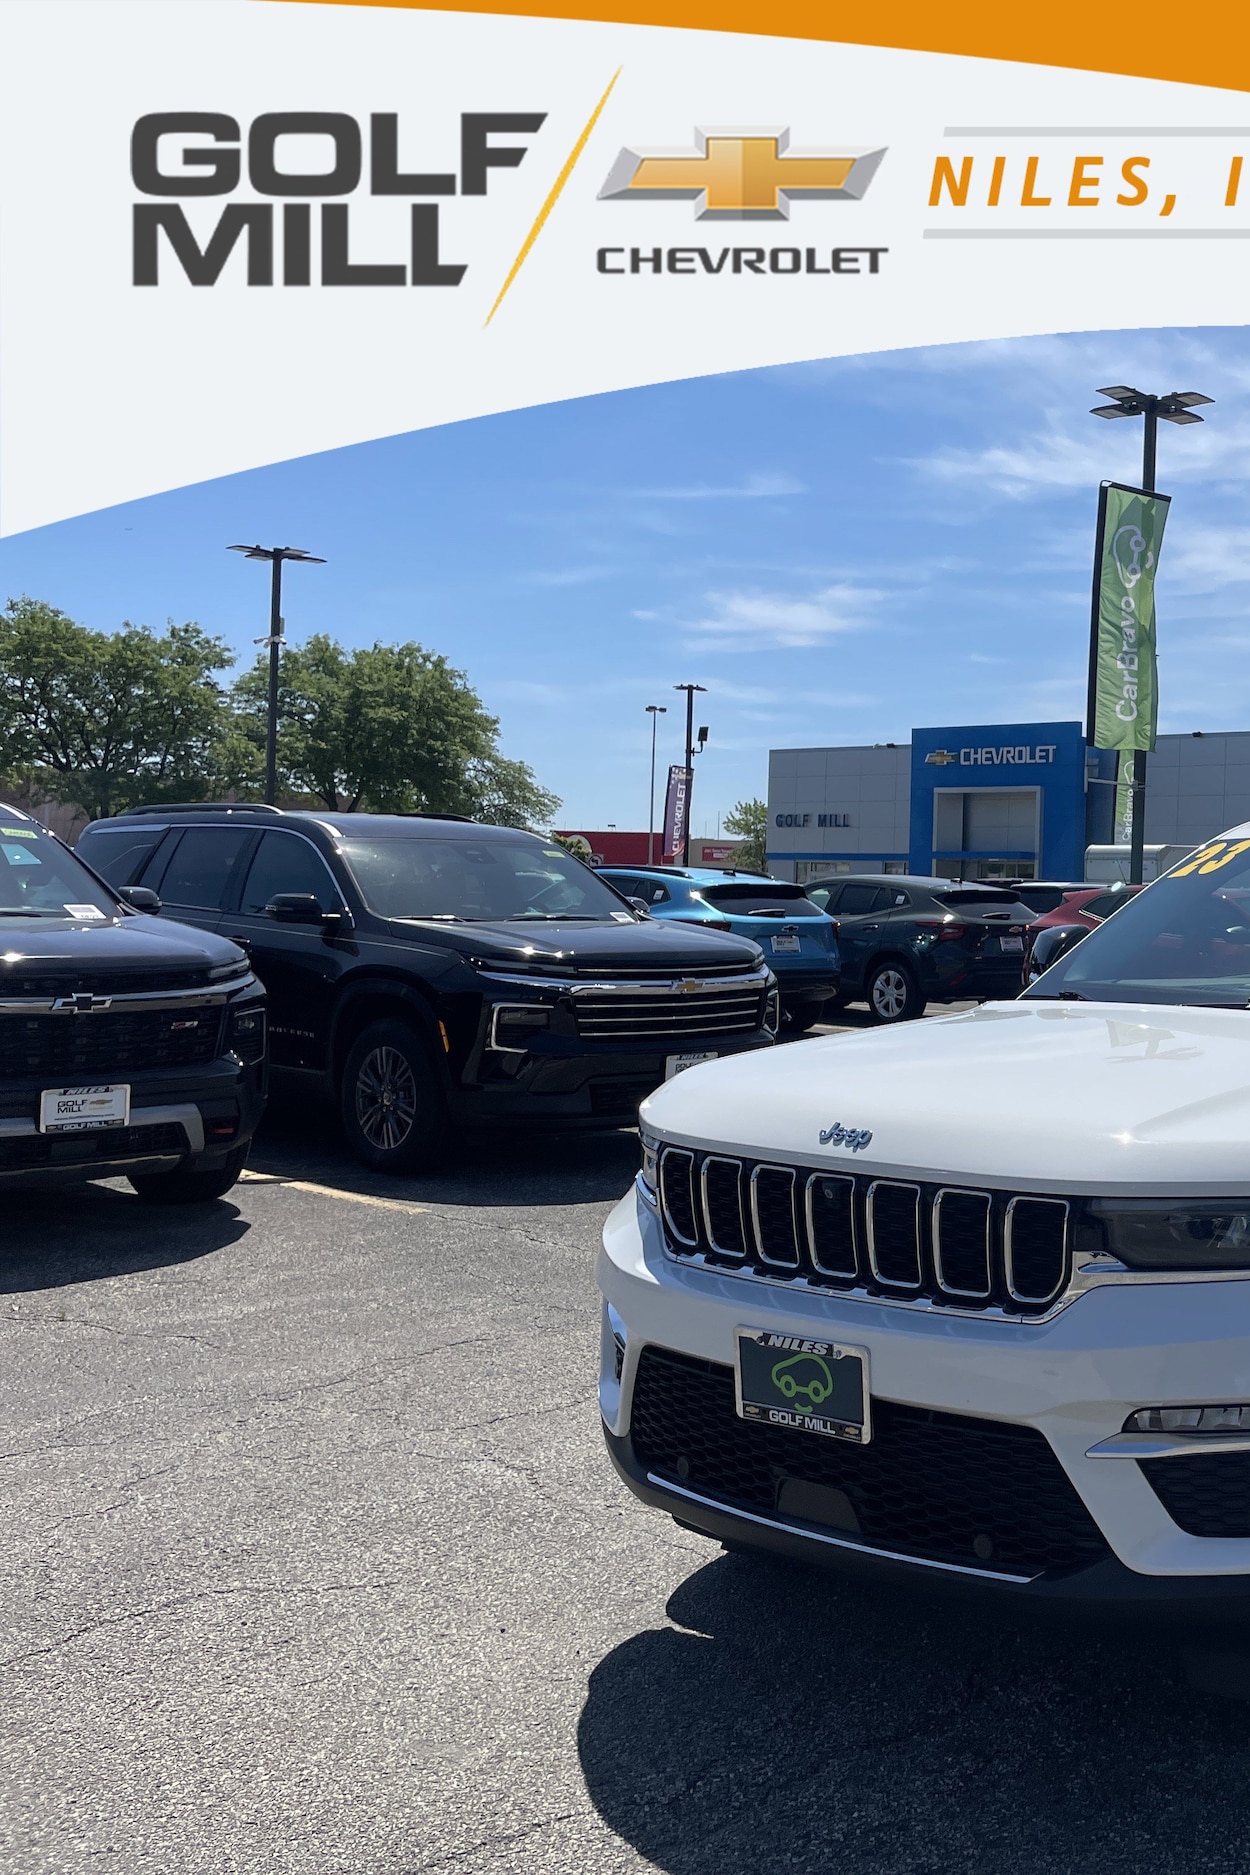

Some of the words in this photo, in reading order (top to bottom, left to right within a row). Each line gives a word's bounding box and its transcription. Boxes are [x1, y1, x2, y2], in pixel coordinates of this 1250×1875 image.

[1116, 596, 1138, 722] CarBravo
[960, 745, 1056, 766] CHEVROLET
[671, 782, 686, 852] CHEVROLET
[775, 814, 809, 828] GOLF
[817, 814, 850, 828] MILL
[1122, 789, 1134, 840] CarBravo
[57, 1099, 88, 1108] GOLF
[57, 1105, 82, 1114] MILL
[63, 1122, 86, 1130] GOLF
[87, 1121, 107, 1129] MILL
[819, 1122, 873, 1153] Jeep
[768, 1335, 829, 1356] NILES
[768, 1410, 804, 1427] GOLF
[804, 1415, 836, 1435] MILL
